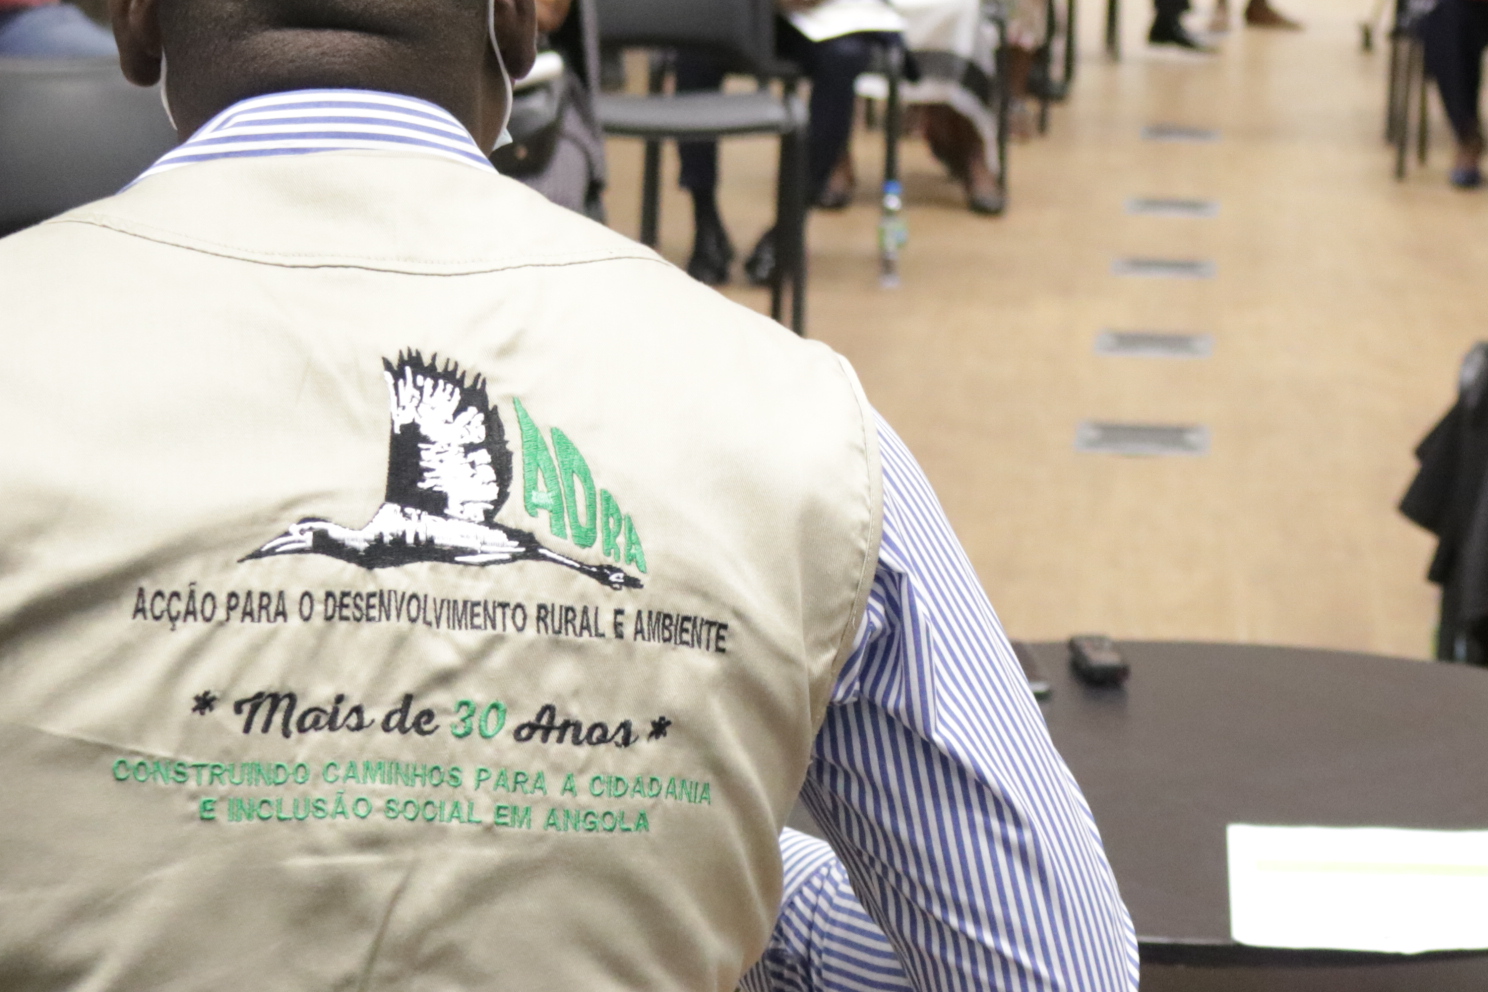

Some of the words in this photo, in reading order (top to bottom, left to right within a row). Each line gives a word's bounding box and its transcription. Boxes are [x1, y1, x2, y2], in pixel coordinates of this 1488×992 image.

[512, 395, 648, 574] ADRA
[132, 582, 217, 631] ACÇÃO
[225, 588, 288, 624] PARA
[299, 588, 315, 621] O
[324, 589, 527, 633] DESENVOLVIMENTO
[535, 601, 606, 638] RURAL
[613, 608, 626, 640] E
[632, 609, 728, 652] AMBIENTE
[233, 691, 373, 738] Mais
[381, 693, 440, 737] de
[450, 699, 506, 739] 30
[513, 703, 637, 747] Anos
[112, 759, 310, 787] CONSTRUINDO
[322, 761, 462, 789] CAMINHOS
[474, 767, 546, 796] PARA
[559, 772, 577, 797] A
[589, 773, 712, 804] CIDADANIA
[199, 797, 216, 820] E
[228, 789, 372, 821] INCLUSÃO
[384, 797, 482, 823] SOCIAL
[493, 803, 532, 829] EM
[543, 807, 650, 833] ANGOLA
